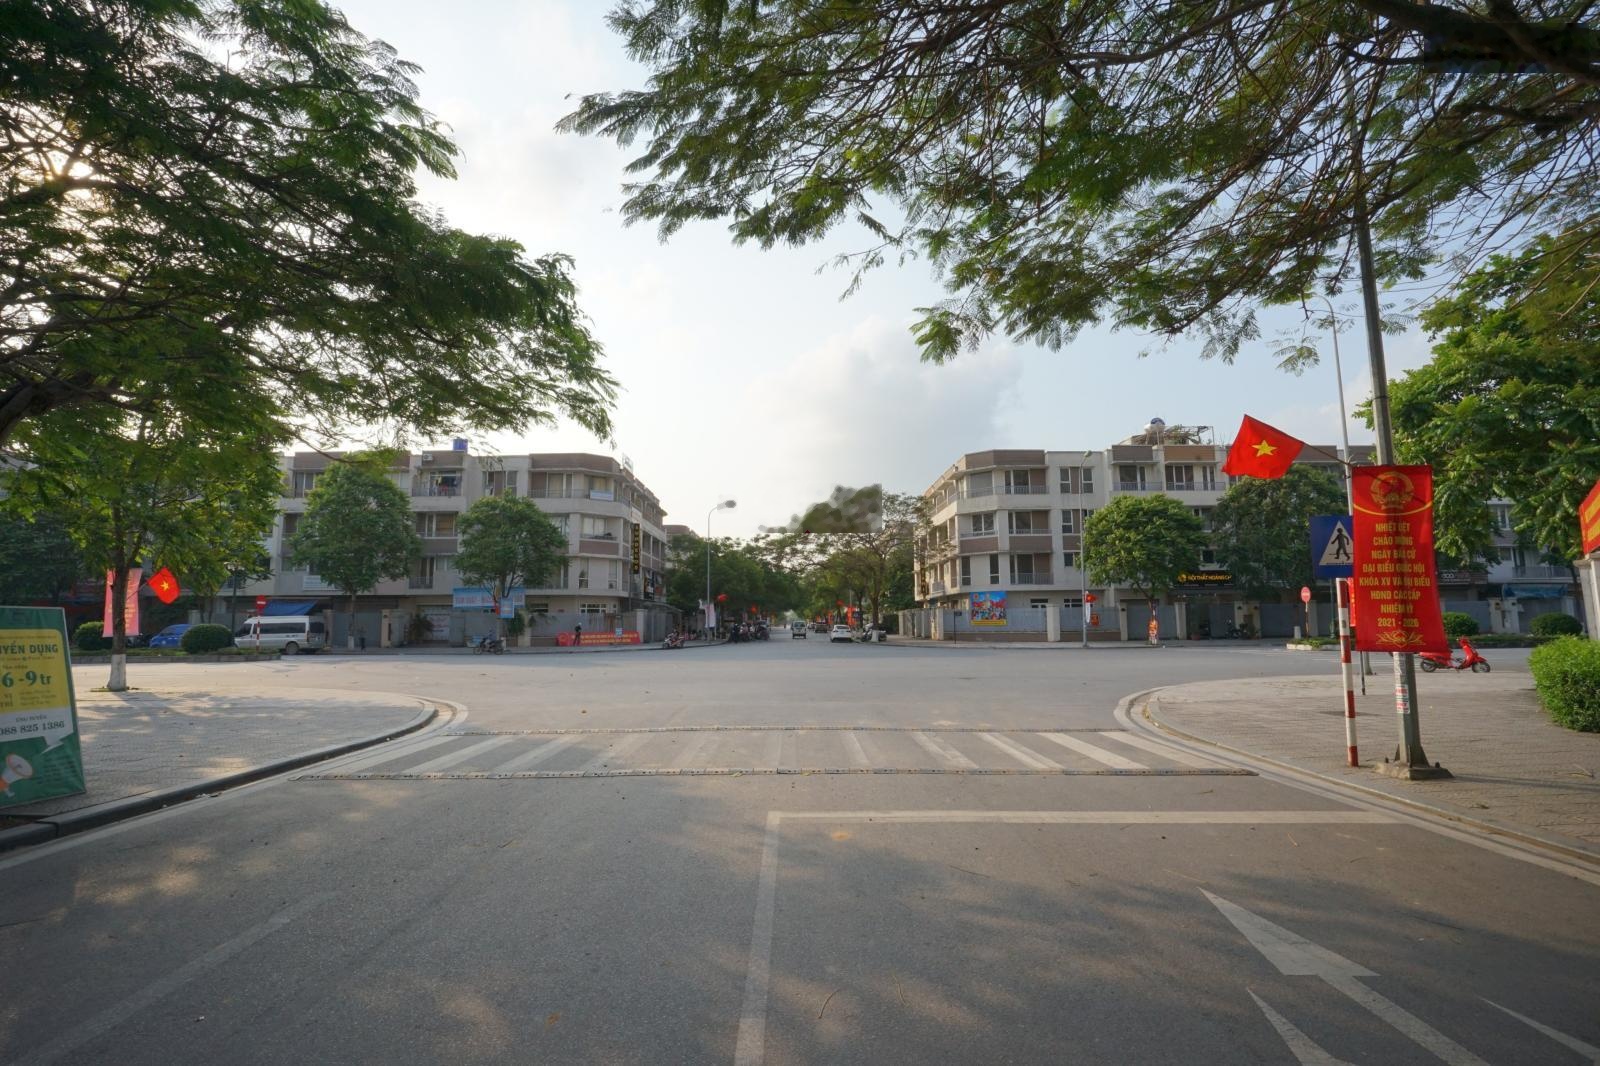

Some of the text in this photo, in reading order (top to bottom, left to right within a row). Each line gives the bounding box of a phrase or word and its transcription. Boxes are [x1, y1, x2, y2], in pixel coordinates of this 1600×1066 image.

[1381, 577, 1391, 586] XV
[1378, 618, 1395, 627] 2021
[40, 673, 51, 685] tr
